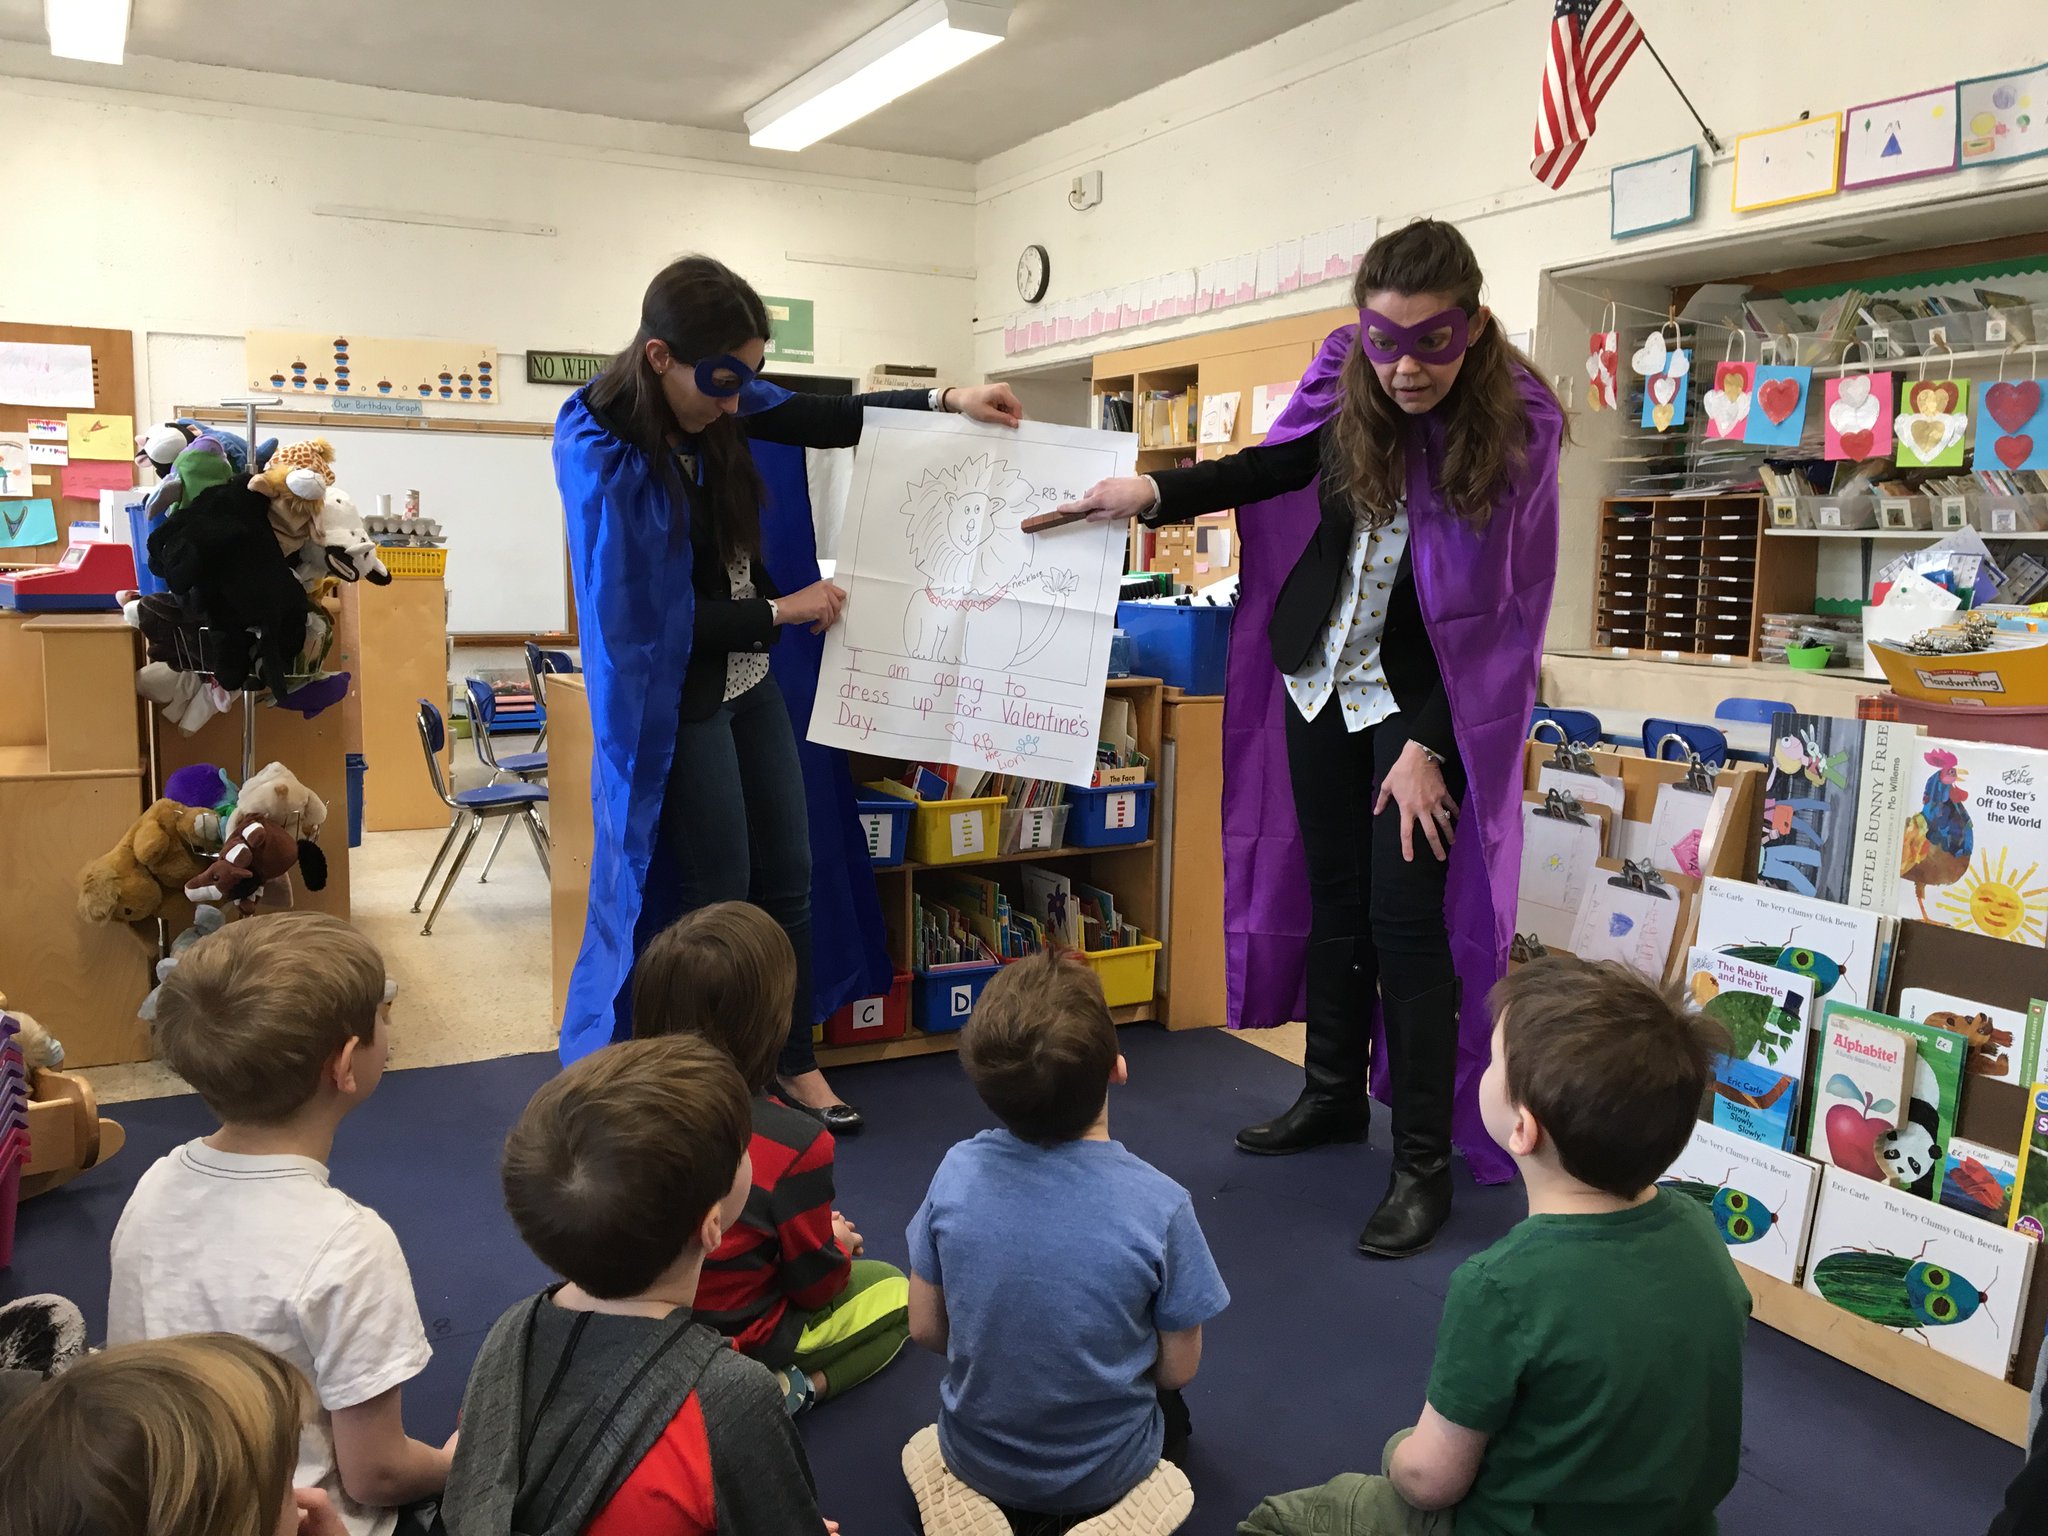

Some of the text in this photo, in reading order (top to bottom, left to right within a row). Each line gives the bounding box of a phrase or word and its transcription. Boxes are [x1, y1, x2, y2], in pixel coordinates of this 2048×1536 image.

[532, 355, 607, 380] NO WHIN
[910, 379, 927, 390] Song
[333, 399, 421, 415] Our Birthday Graph
[1063, 489, 1077, 500] the
[1011, 570, 1043, 589] necklace
[845, 648, 1026, 704] I am going to
[1920, 673, 2000, 691] Handwriting
[839, 672, 1090, 738] dress up for Valentine's
[838, 701, 878, 741] Day.
[972, 732, 994, 753] RB
[1871, 724, 1890, 773] FREE
[985, 750, 1002, 762] the
[996, 753, 1027, 771] Lion
[1109, 774, 1136, 783] The Face
[1889, 757, 1901, 791] Willems
[1887, 796, 1897, 810] Mo
[1985, 785, 2036, 802] Rooster's
[1863, 778, 1884, 843] BUNNY
[1976, 796, 2030, 814] Off to See
[1987, 811, 2042, 829] the World
[1726, 892, 1745, 902] Carle
[1755, 898, 1858, 930] The Very Clumsy Click Beetle
[1716, 959, 1735, 973] The
[1737, 965, 1768, 982] Rabbit
[1717, 972, 1783, 997] and the Turtle
[954, 992, 970, 1012] D
[862, 1005, 875, 1023] C
[1833, 1033, 1898, 1064] Alphabite!
[1727, 1076, 1764, 1095] Eric Carle
[1729, 1112, 1754, 1128] Slowly,
[1696, 1134, 1792, 1179] The Very Clumsy Click Beetle
[1972, 1150, 1990, 1160] Carle
[2003, 1159, 2016, 1169] The
[1831, 1181, 2004, 1255] Eric Carle The Very Clumsy Click Beetle
